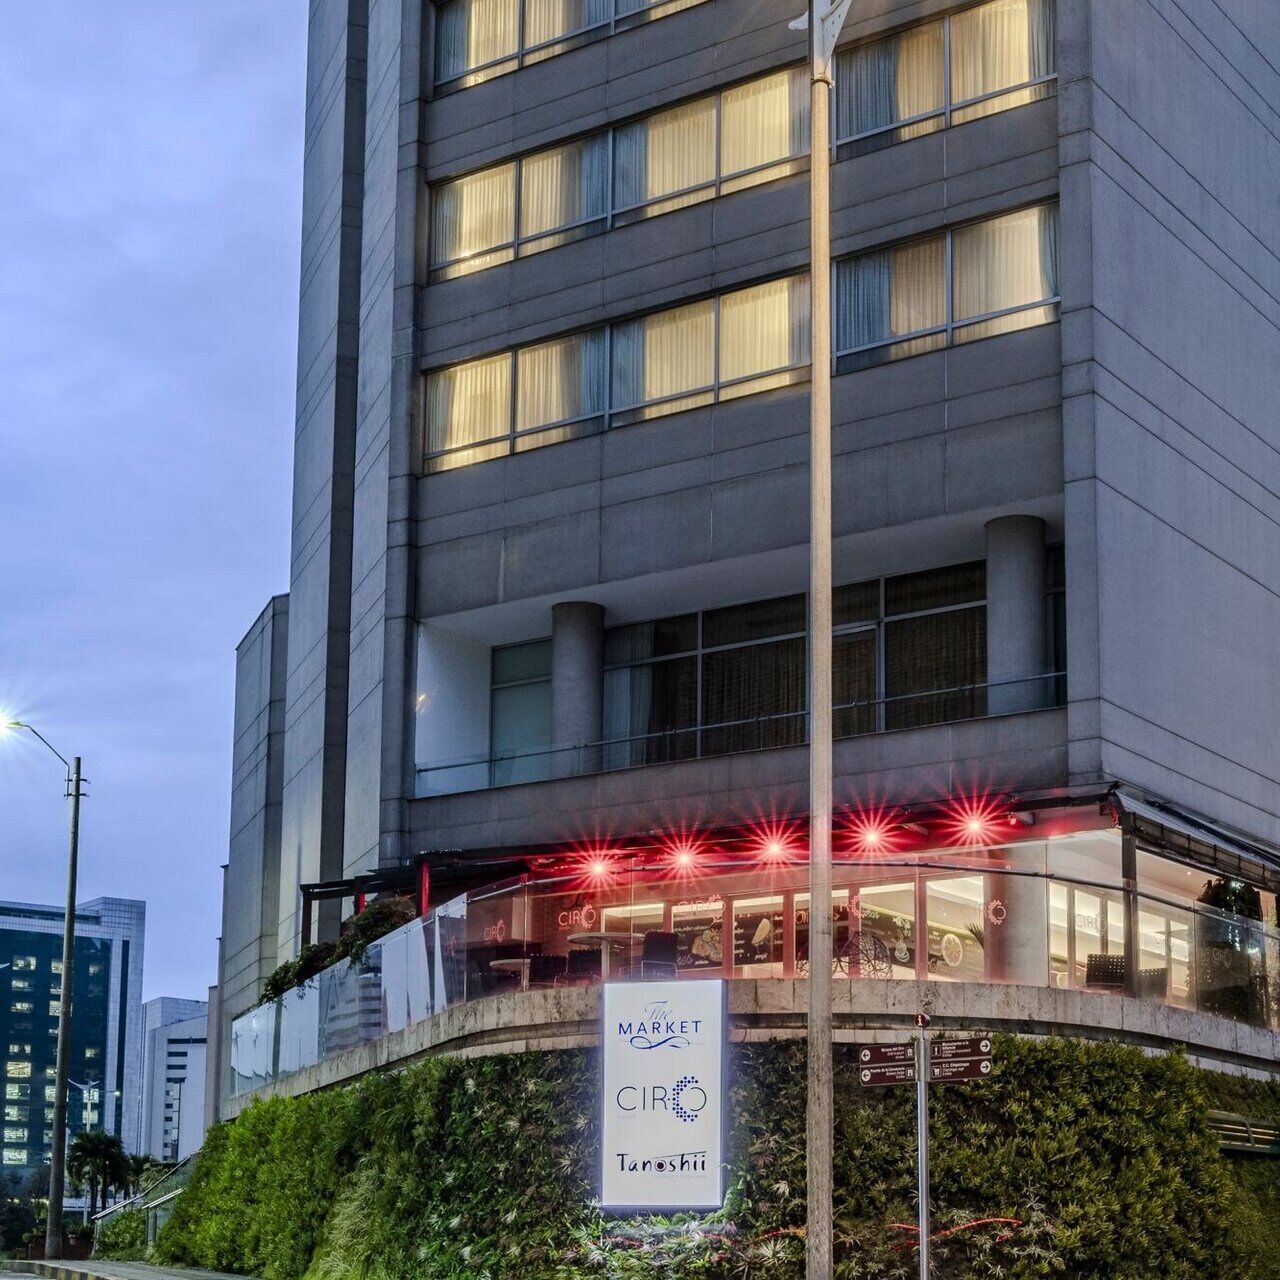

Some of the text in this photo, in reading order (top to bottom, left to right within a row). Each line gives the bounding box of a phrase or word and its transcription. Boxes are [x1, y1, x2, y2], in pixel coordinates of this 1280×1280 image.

[557, 904, 597, 929] CIRO
[644, 1001, 673, 1022] The
[618, 1020, 702, 1035] MARKET
[616, 1076, 707, 1122] CIRO
[616, 1151, 707, 1172] Tanoshii
